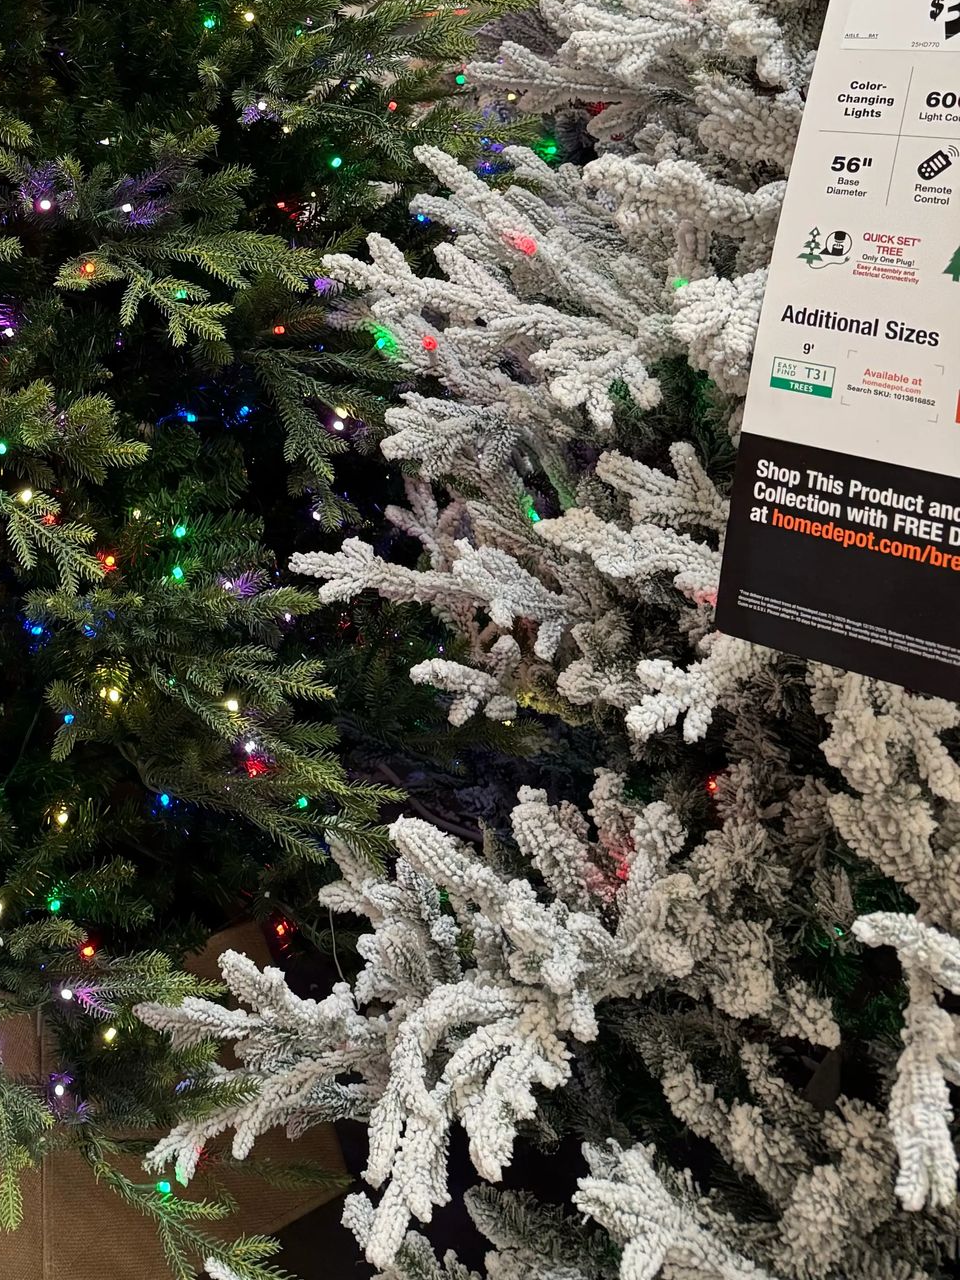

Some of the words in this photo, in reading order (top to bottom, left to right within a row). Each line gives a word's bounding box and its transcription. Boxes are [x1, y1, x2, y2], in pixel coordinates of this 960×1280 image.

[850, 81, 887, 90] Color-
[837, 94, 895, 106] Changing
[844, 108, 882, 118] Lights
[919, 112, 943, 122] Light
[830, 156, 873, 173] 56"
[837, 177, 860, 186] Base
[826, 186, 868, 197] Diameter
[914, 184, 952, 195] Remote
[913, 194, 950, 205] Control
[862, 232, 895, 245] QUICK
[876, 245, 904, 257] TREE
[861, 253, 879, 262] Only
[895, 259, 915, 267] Plug!
[856, 263, 871, 271] Easy
[872, 264, 903, 276] Assembly
[852, 269, 880, 279] Electrical
[880, 273, 920, 284] Connectivity
[780, 304, 880, 338] Additional
[885, 320, 940, 347] Sizes
[802, 342, 815, 355] 9'
[777, 361, 798, 370] EASY
[776, 368, 797, 377] FIND
[804, 366, 827, 381] T31
[863, 368, 909, 384] Available
[911, 377, 923, 386] at
[789, 381, 814, 393] TREES
[846, 384, 872, 395] Search
[873, 389, 892, 399] SKU:
[862, 379, 922, 395] homedepot.com
[756, 458, 801, 487] Shop
[806, 469, 844, 496] This
[848, 479, 925, 515] Product
[749, 505, 769, 524] at
[753, 481, 841, 518] Collection
[846, 505, 888, 530] with
[893, 513, 944, 543] FREE
